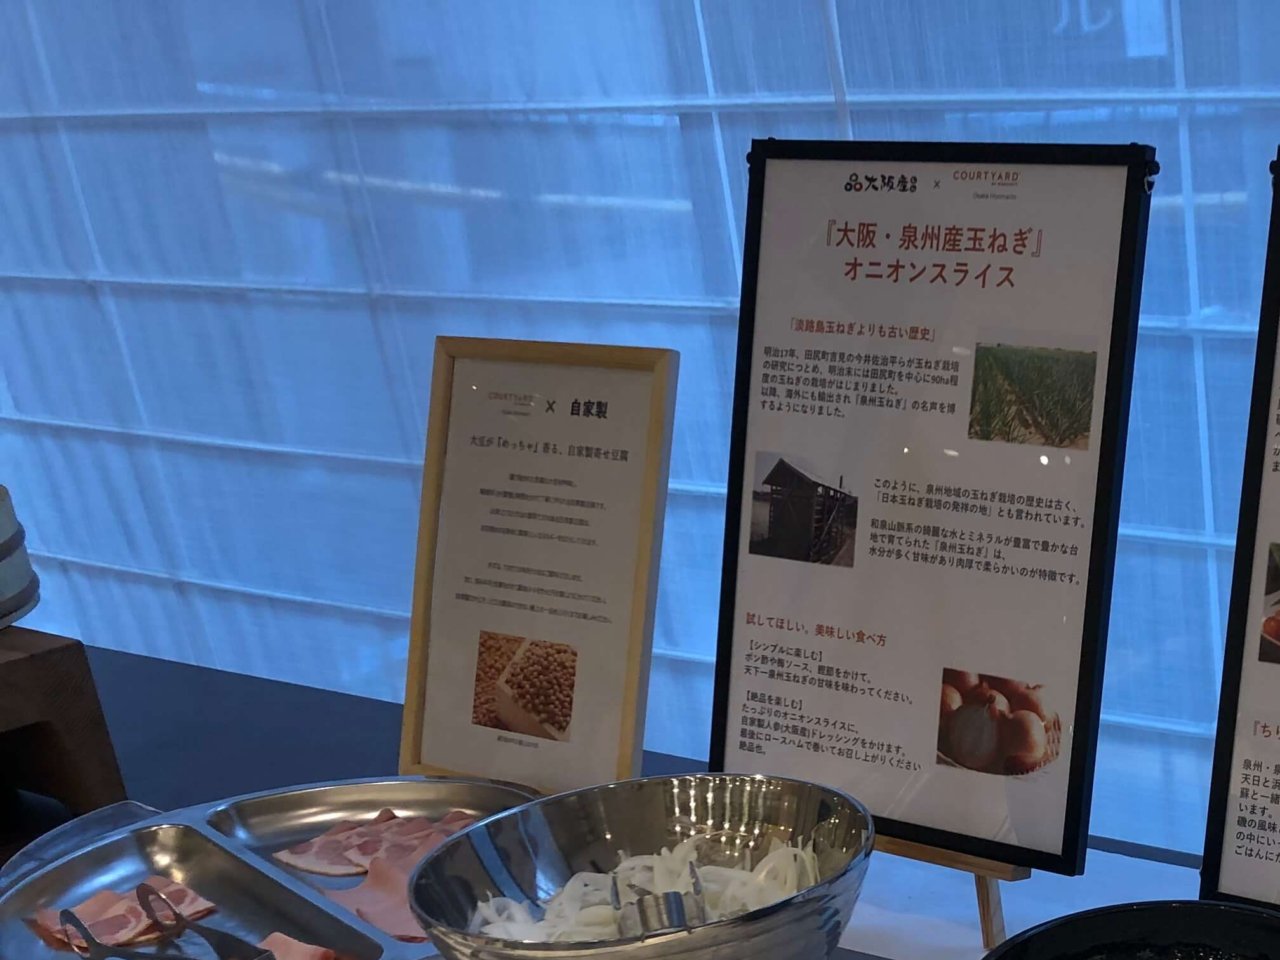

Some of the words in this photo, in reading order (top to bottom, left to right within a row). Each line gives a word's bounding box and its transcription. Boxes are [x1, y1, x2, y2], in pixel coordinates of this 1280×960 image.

[953, 170, 1019, 181] COURTYARD
[825, 219, 1042, 257] 『大阪・泉州産玉ねぎ』
[844, 256, 1015, 289] オニオンスライス
[570, 398, 608, 419] 自家製
[760, 399, 844, 418] するようになりました。
[1238, 802, 1273, 817] います。
